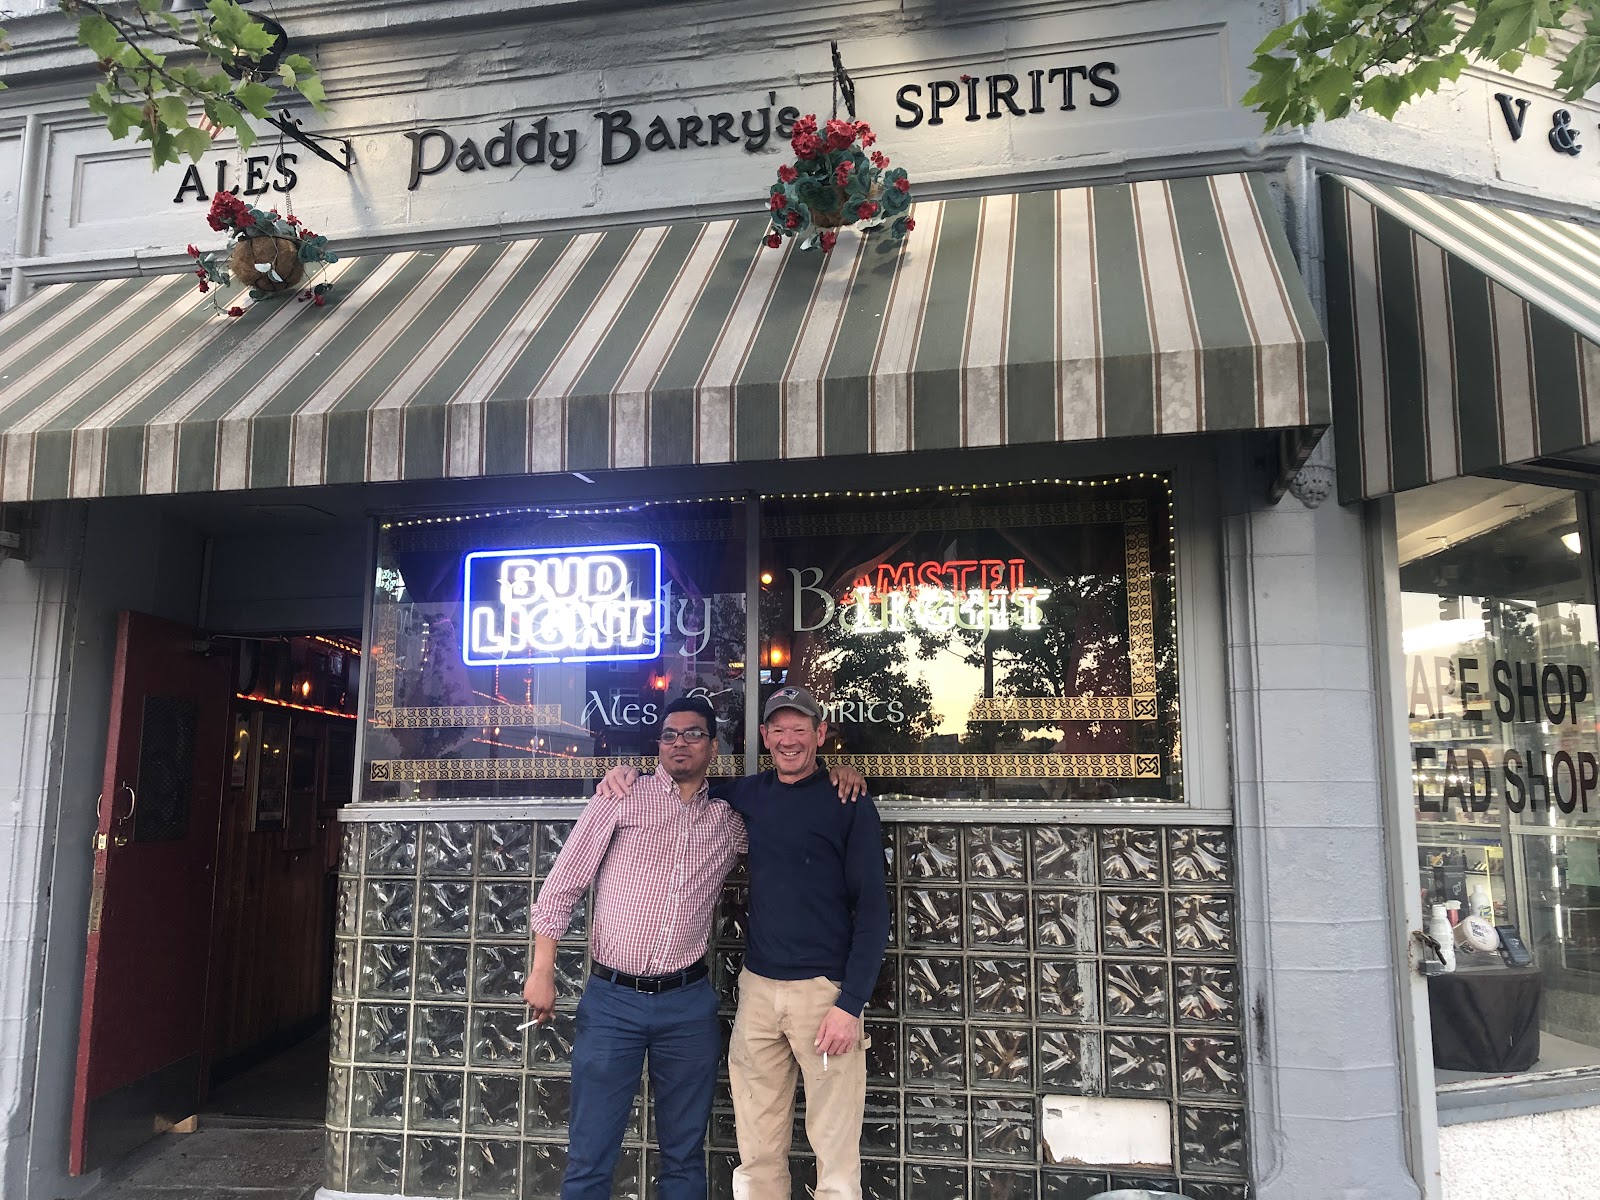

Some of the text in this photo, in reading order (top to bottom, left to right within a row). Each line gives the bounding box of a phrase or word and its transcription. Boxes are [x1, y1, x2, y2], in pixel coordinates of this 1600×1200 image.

[895, 61, 1121, 129] SPIRITS
[1494, 92, 1583, 157] V &
[173, 152, 298, 203] ALES
[403, 115, 578, 191] Paddy
[500, 555, 628, 606] BUD
[840, 558, 1038, 606] AMSTEL
[471, 600, 653, 654] LIGHT
[580, 690, 658, 727] Ales
[1409, 655, 1588, 725] APE SHOP
[1415, 747, 1598, 814] EAD SHOP
